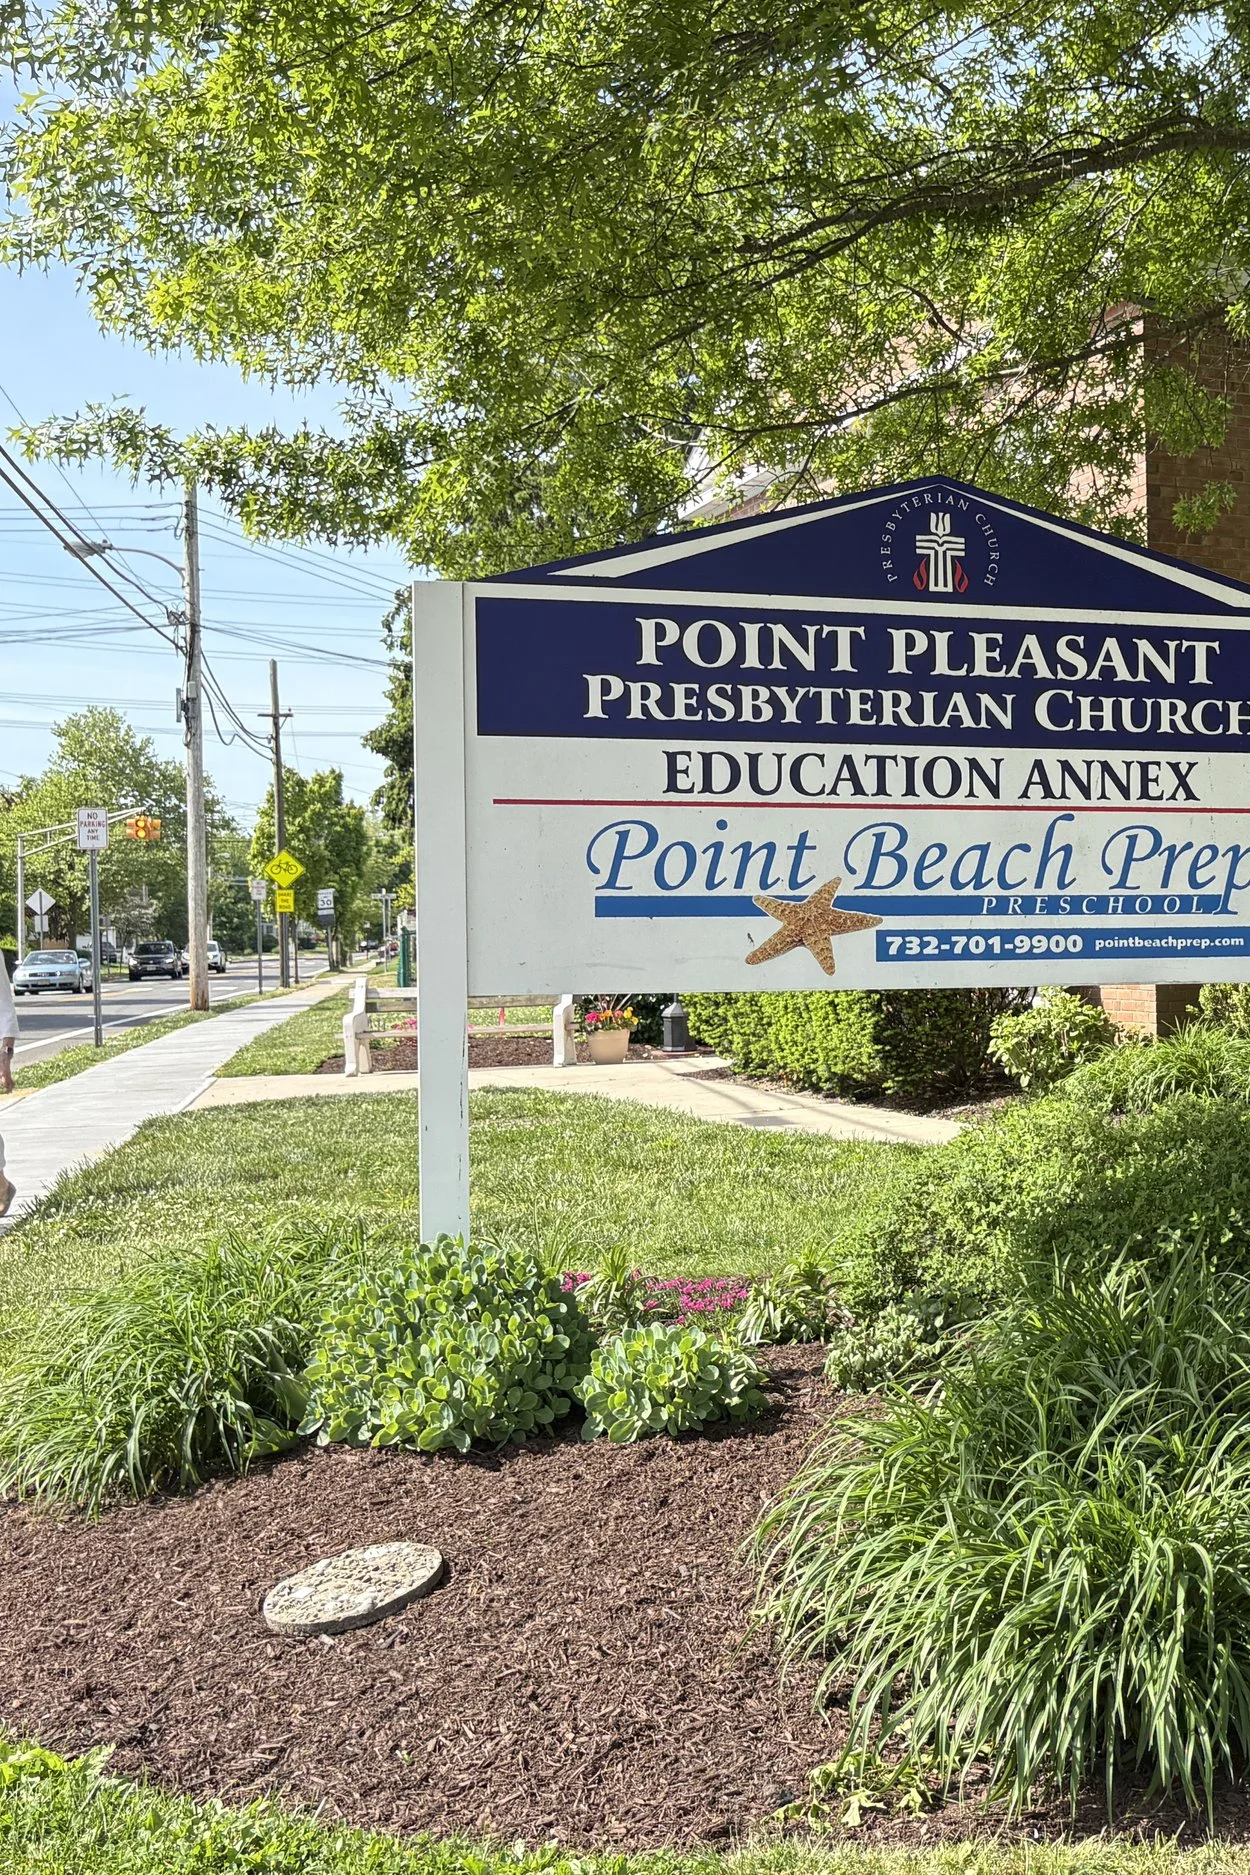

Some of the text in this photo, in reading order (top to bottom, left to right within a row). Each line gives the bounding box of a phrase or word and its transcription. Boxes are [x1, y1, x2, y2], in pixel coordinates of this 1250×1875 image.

[881, 493, 1000, 586] PRESBYTERIAN CHURCH
[635, 617, 1220, 685] POINT PLEASANT
[582, 673, 1016, 730] PRESBYTERIAN
[662, 750, 1201, 801] EDUCATION ANNEX
[80, 820, 106, 828] PARKING
[87, 812, 98, 820] NO
[586, 818, 817, 891] Point
[843, 813, 1077, 891] Beach
[320, 899, 332, 907] 30
[980, 896, 1204, 915] PRESCHOOL
[885, 934, 1245, 956] 732-701-9900 pointbeachprep.com
